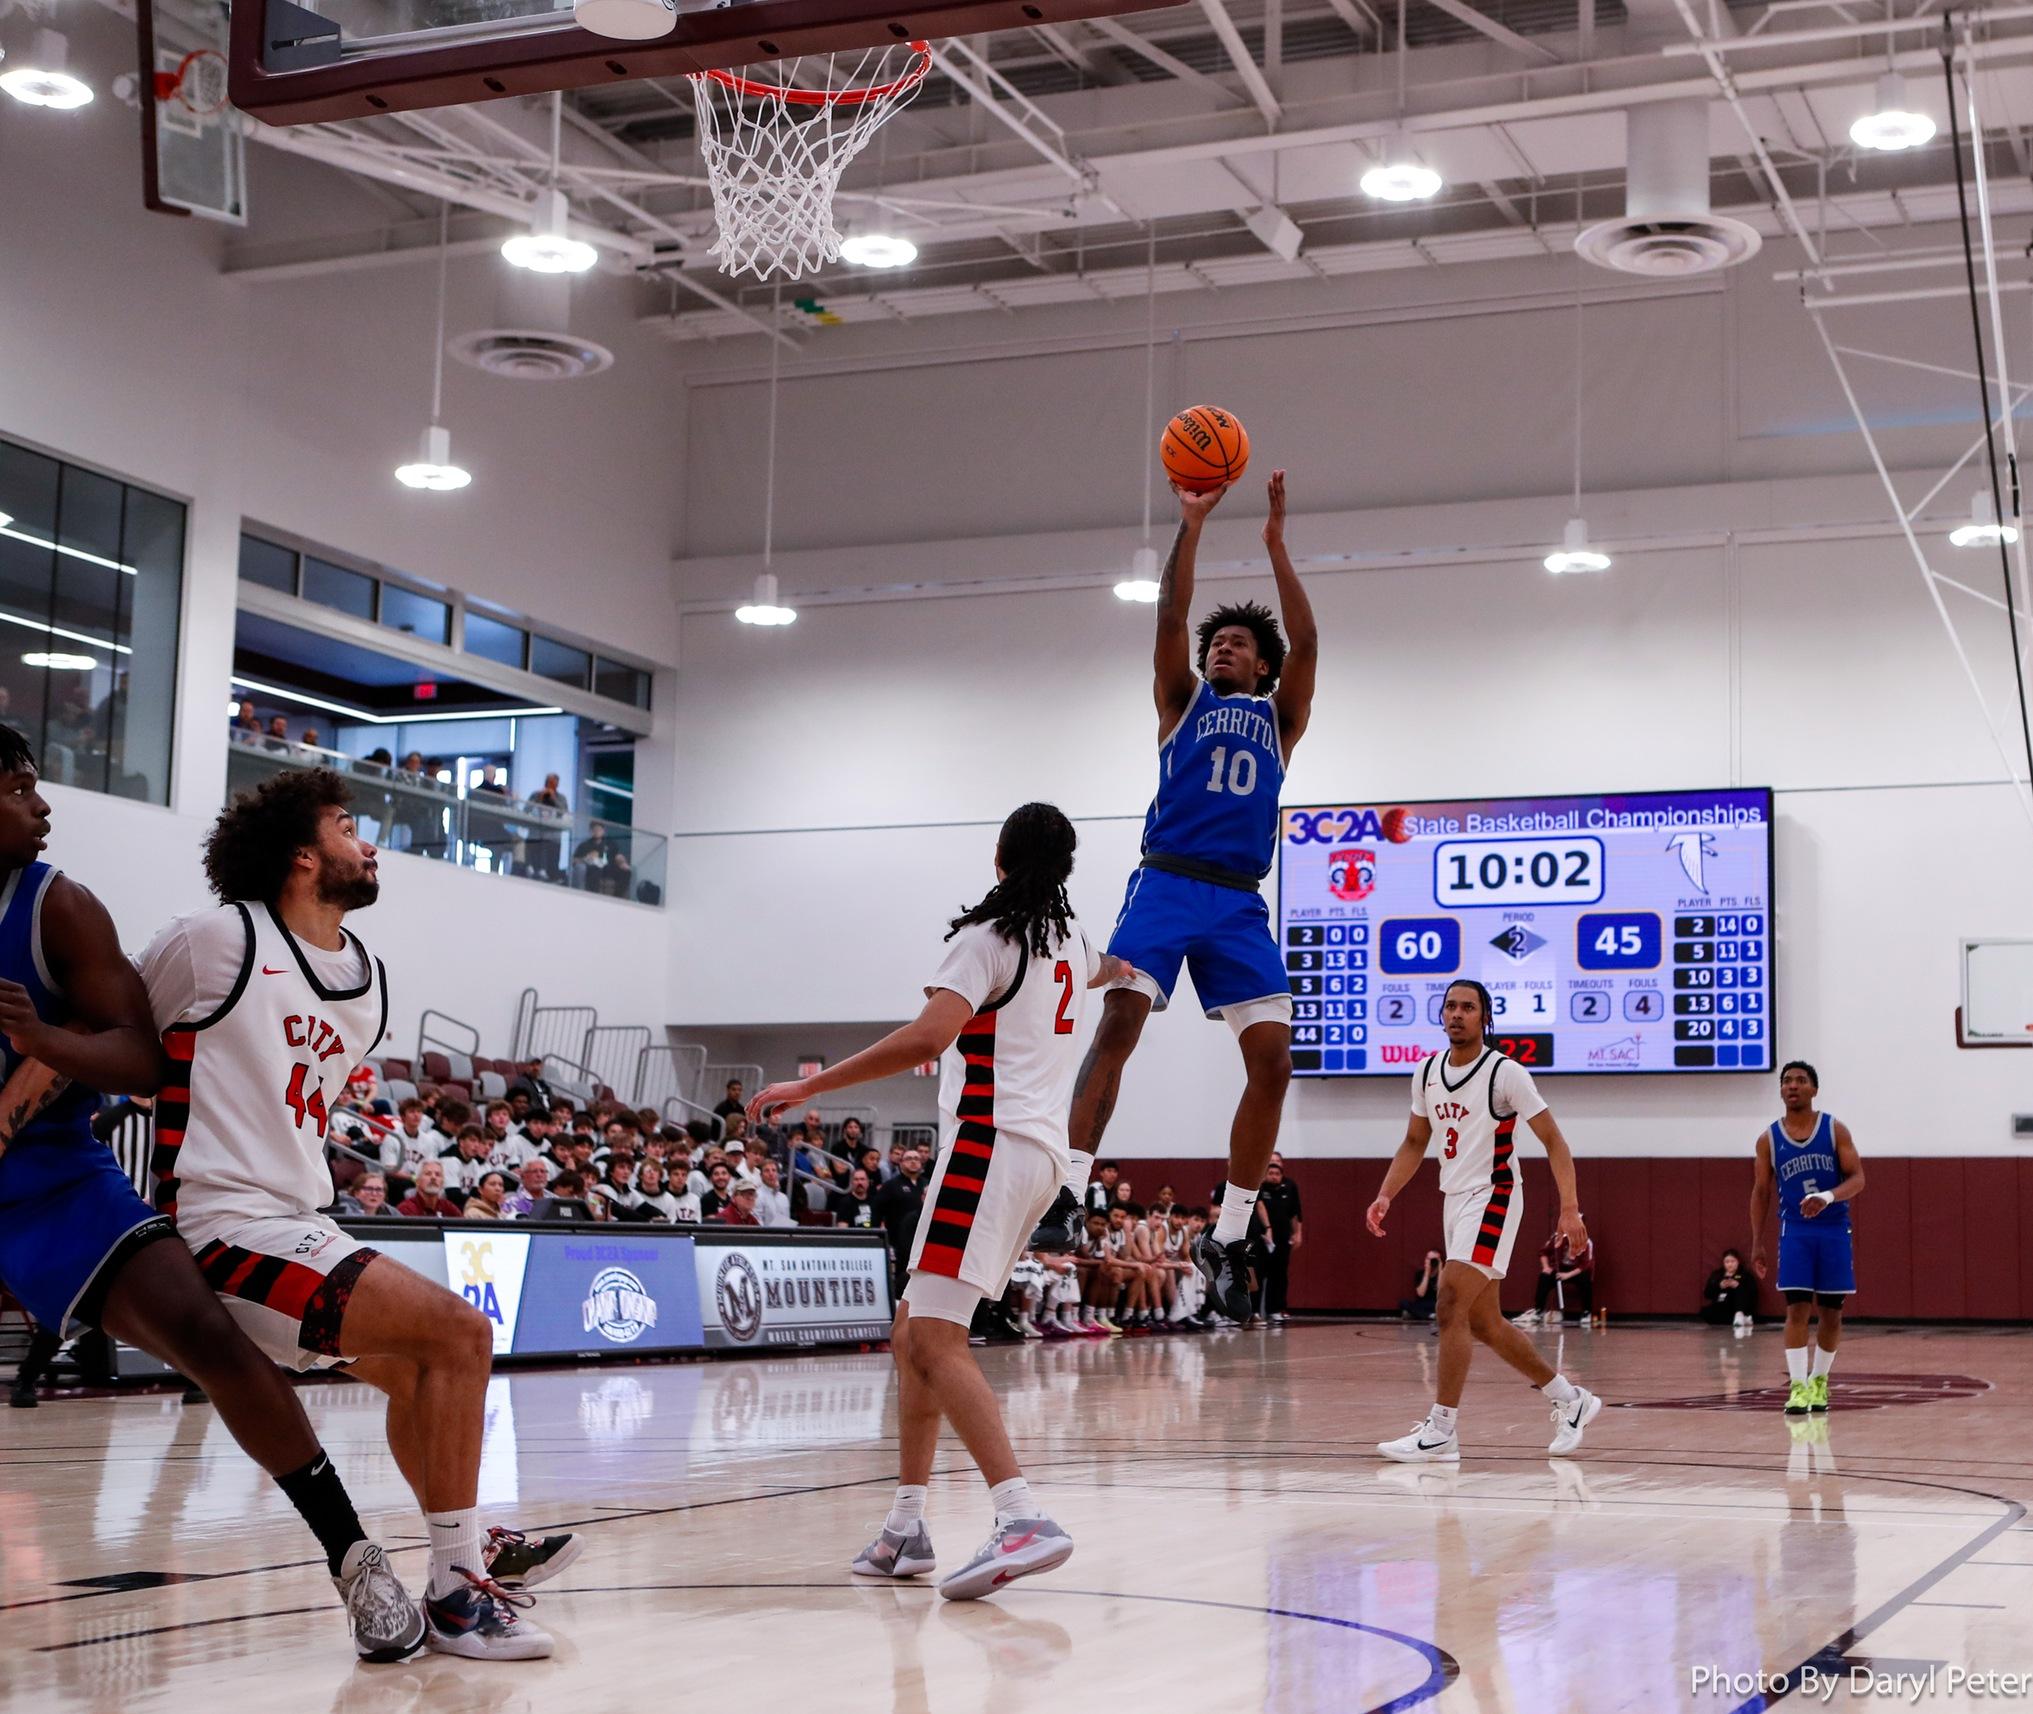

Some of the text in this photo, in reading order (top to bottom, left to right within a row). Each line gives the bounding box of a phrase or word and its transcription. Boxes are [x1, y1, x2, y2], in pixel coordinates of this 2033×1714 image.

[1178, 413, 1212, 452] Wilso
[1196, 707, 1275, 759] CERRITO
[1206, 746, 1257, 796] 10
[1288, 808, 1385, 845] 3C2A
[1403, 803, 1761, 836] State Basketball Championships
[1449, 850, 1591, 891] 10:02
[1678, 897, 1712, 908] PLAYER
[1290, 908, 1321, 918] PLAYER
[1502, 912, 1535, 923] PERIOD
[1693, 917, 1758, 933] 2 14 0
[1301, 927, 1365, 943] 2 0 0
[1509, 932, 1525, 952] 2
[1594, 925, 1643, 956] 45
[1396, 931, 1442, 960] 60
[1693, 942, 1757, 959] 5 11 1
[1301, 952, 1364, 968] 3 13 1
[1301, 977, 1364, 993] 5 6 2
[1524, 981, 1552, 990] FOULS
[1569, 978, 1658, 989] TIMEOUTS FOULS
[1688, 968, 1758, 985] 10 3 3
[1054, 960, 1075, 1034] 2
[1382, 984, 1410, 993] FOULS
[1297, 1003, 1363, 1018] 13 11 1
[1390, 1000, 1404, 1019] 2
[1493, 995, 1546, 1015] 3 1
[1583, 996, 1651, 1016] 2 4
[1688, 994, 1758, 1011] 13 6 1
[1296, 1026, 1364, 1042] 44 2 0
[1688, 1020, 1758, 1036] 20 4 3
[283, 1014, 345, 1062] CITY
[1500, 1039, 1536, 1063] 22
[1610, 1049, 1634, 1060] SAC
[285, 1062, 328, 1139] 44
[1434, 1102, 1470, 1122] CITY
[1444, 1127, 1459, 1160] 3
[1780, 1153, 1834, 1182] CERRITOS
[1802, 1178, 1820, 1194] 5
[295, 1230, 326, 1255] CITY
[781, 1260, 797, 1271] SAN
[801, 1260, 836, 1272] ANTONIO
[840, 1260, 873, 1271] COLLEGE
[764, 1278, 877, 1308] MOUNTIES
[800, 1328, 844, 1341] CHAMPIONS
[849, 1327, 881, 1338] COMPETE
